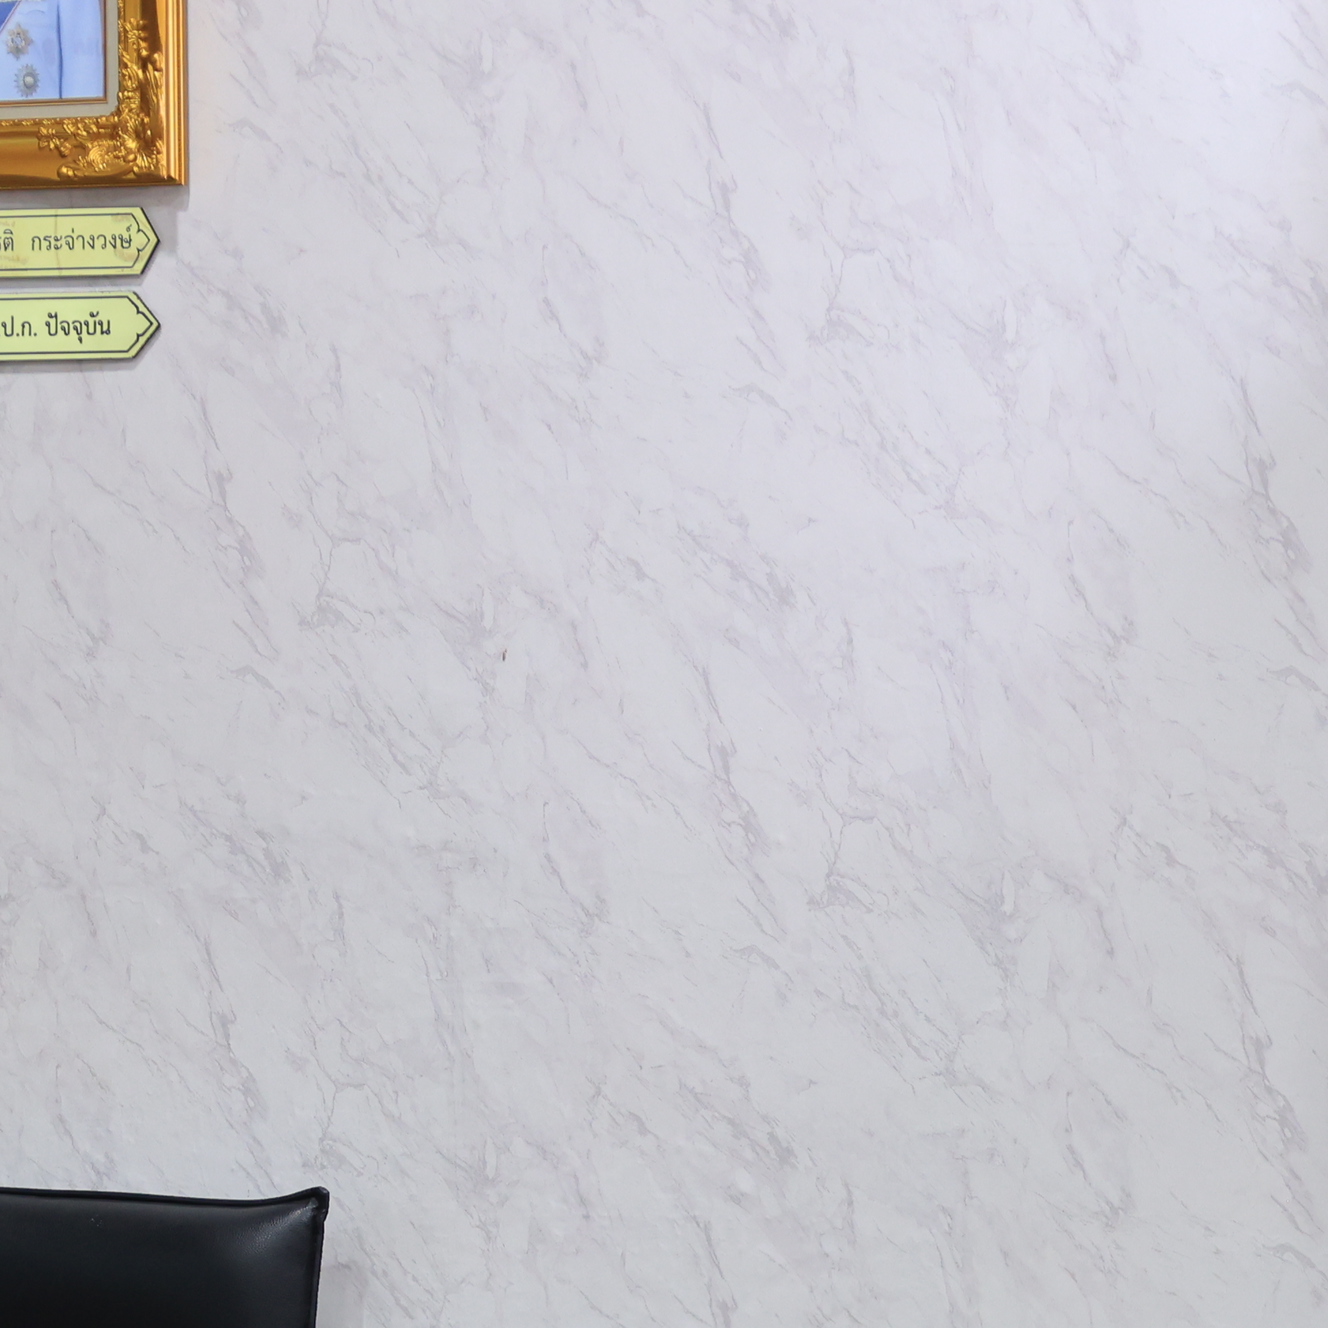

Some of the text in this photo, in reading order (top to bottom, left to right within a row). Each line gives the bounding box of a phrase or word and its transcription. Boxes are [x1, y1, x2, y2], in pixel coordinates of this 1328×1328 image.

[30, 224, 133, 252] กระจ่างวงษ์
[45, 311, 112, 344] ปัจจุบัน
